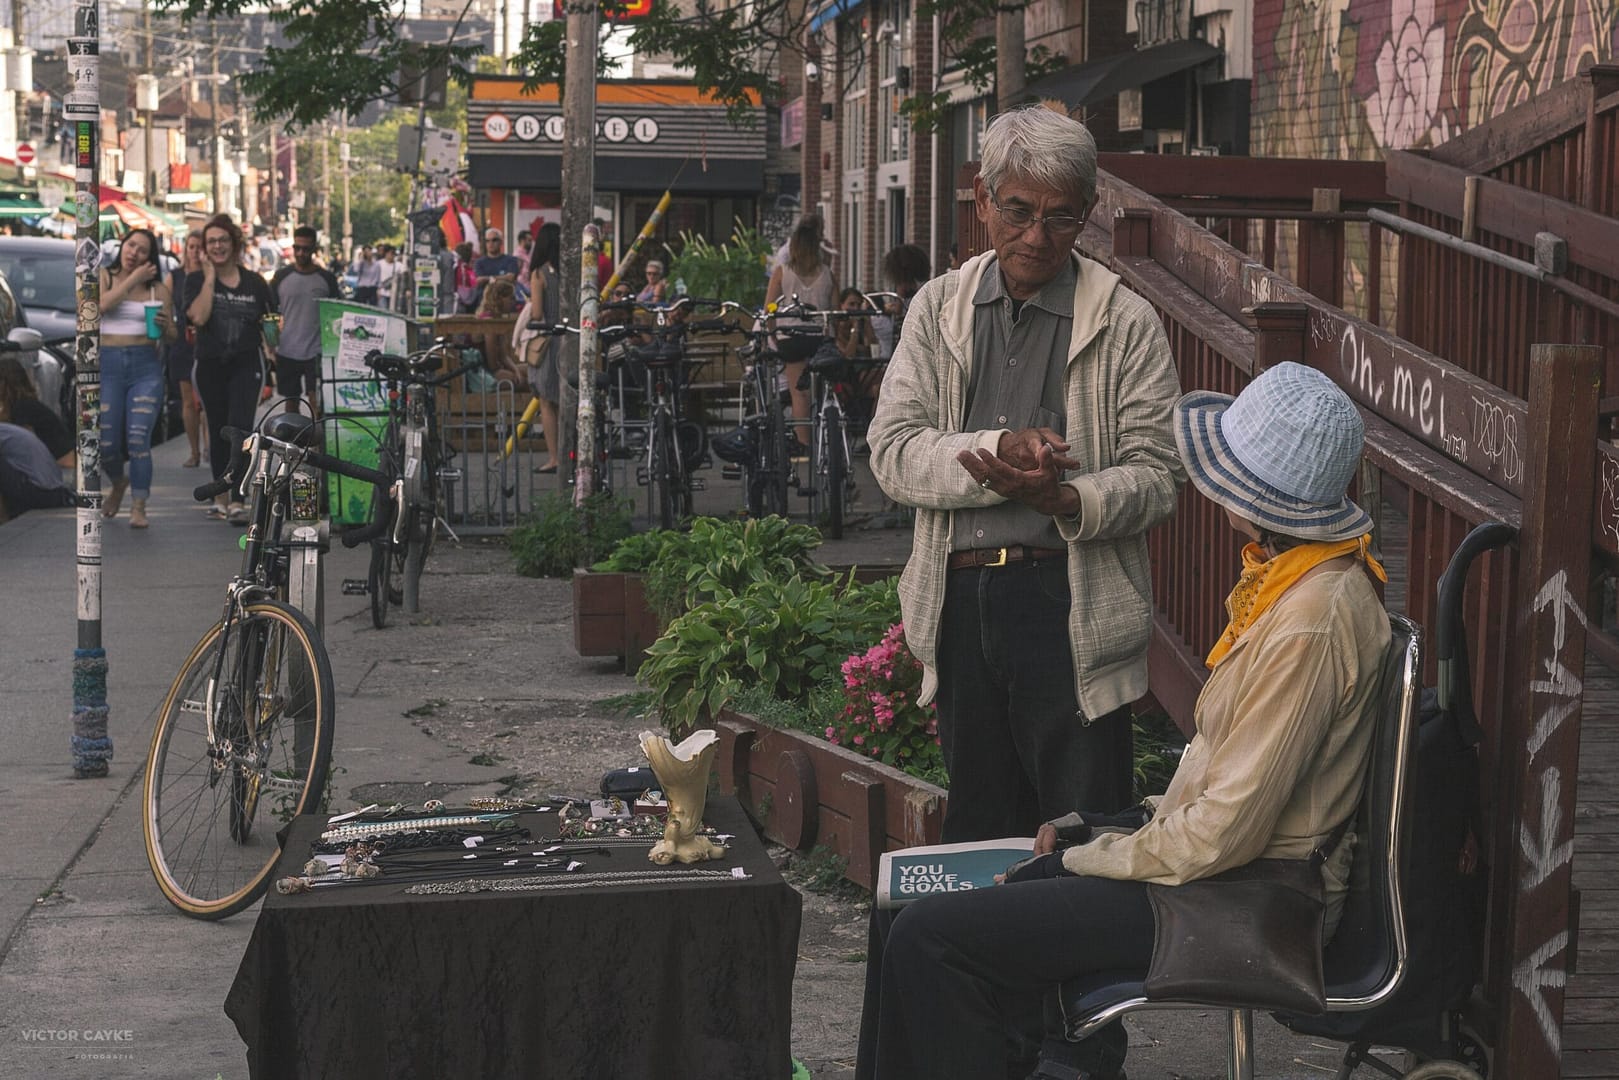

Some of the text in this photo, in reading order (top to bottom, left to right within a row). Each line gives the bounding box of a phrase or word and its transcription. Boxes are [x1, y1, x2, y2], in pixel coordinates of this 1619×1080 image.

[487, 121, 509, 132] NU
[899, 864, 943, 876] YOU
[900, 873, 959, 884] HAVE
[899, 881, 980, 894] GOALS.
